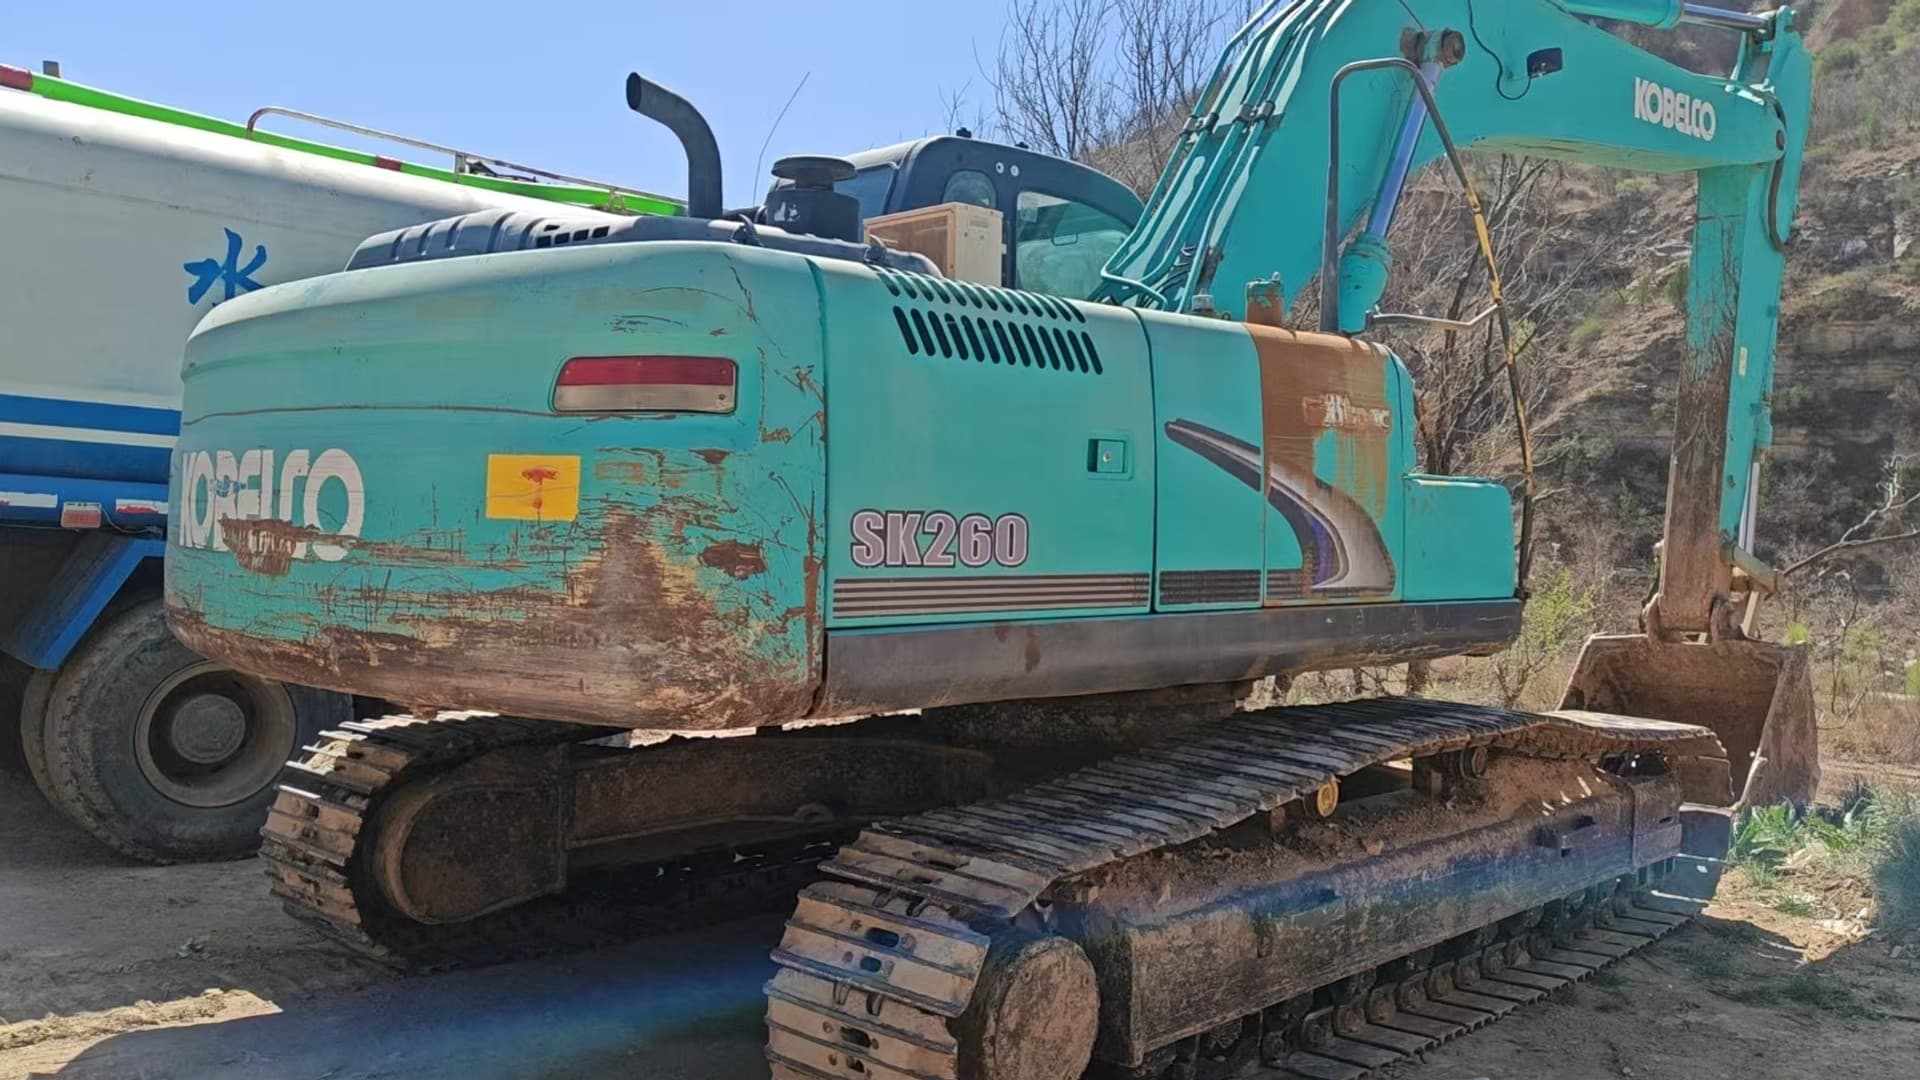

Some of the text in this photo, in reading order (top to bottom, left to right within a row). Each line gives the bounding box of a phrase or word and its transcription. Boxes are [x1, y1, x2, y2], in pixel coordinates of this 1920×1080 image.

[1634, 76, 1716, 141] KOBELCO
[183, 226, 267, 305] 水
[179, 448, 365, 562] KOBELCO
[851, 508, 1029, 569] SK260
